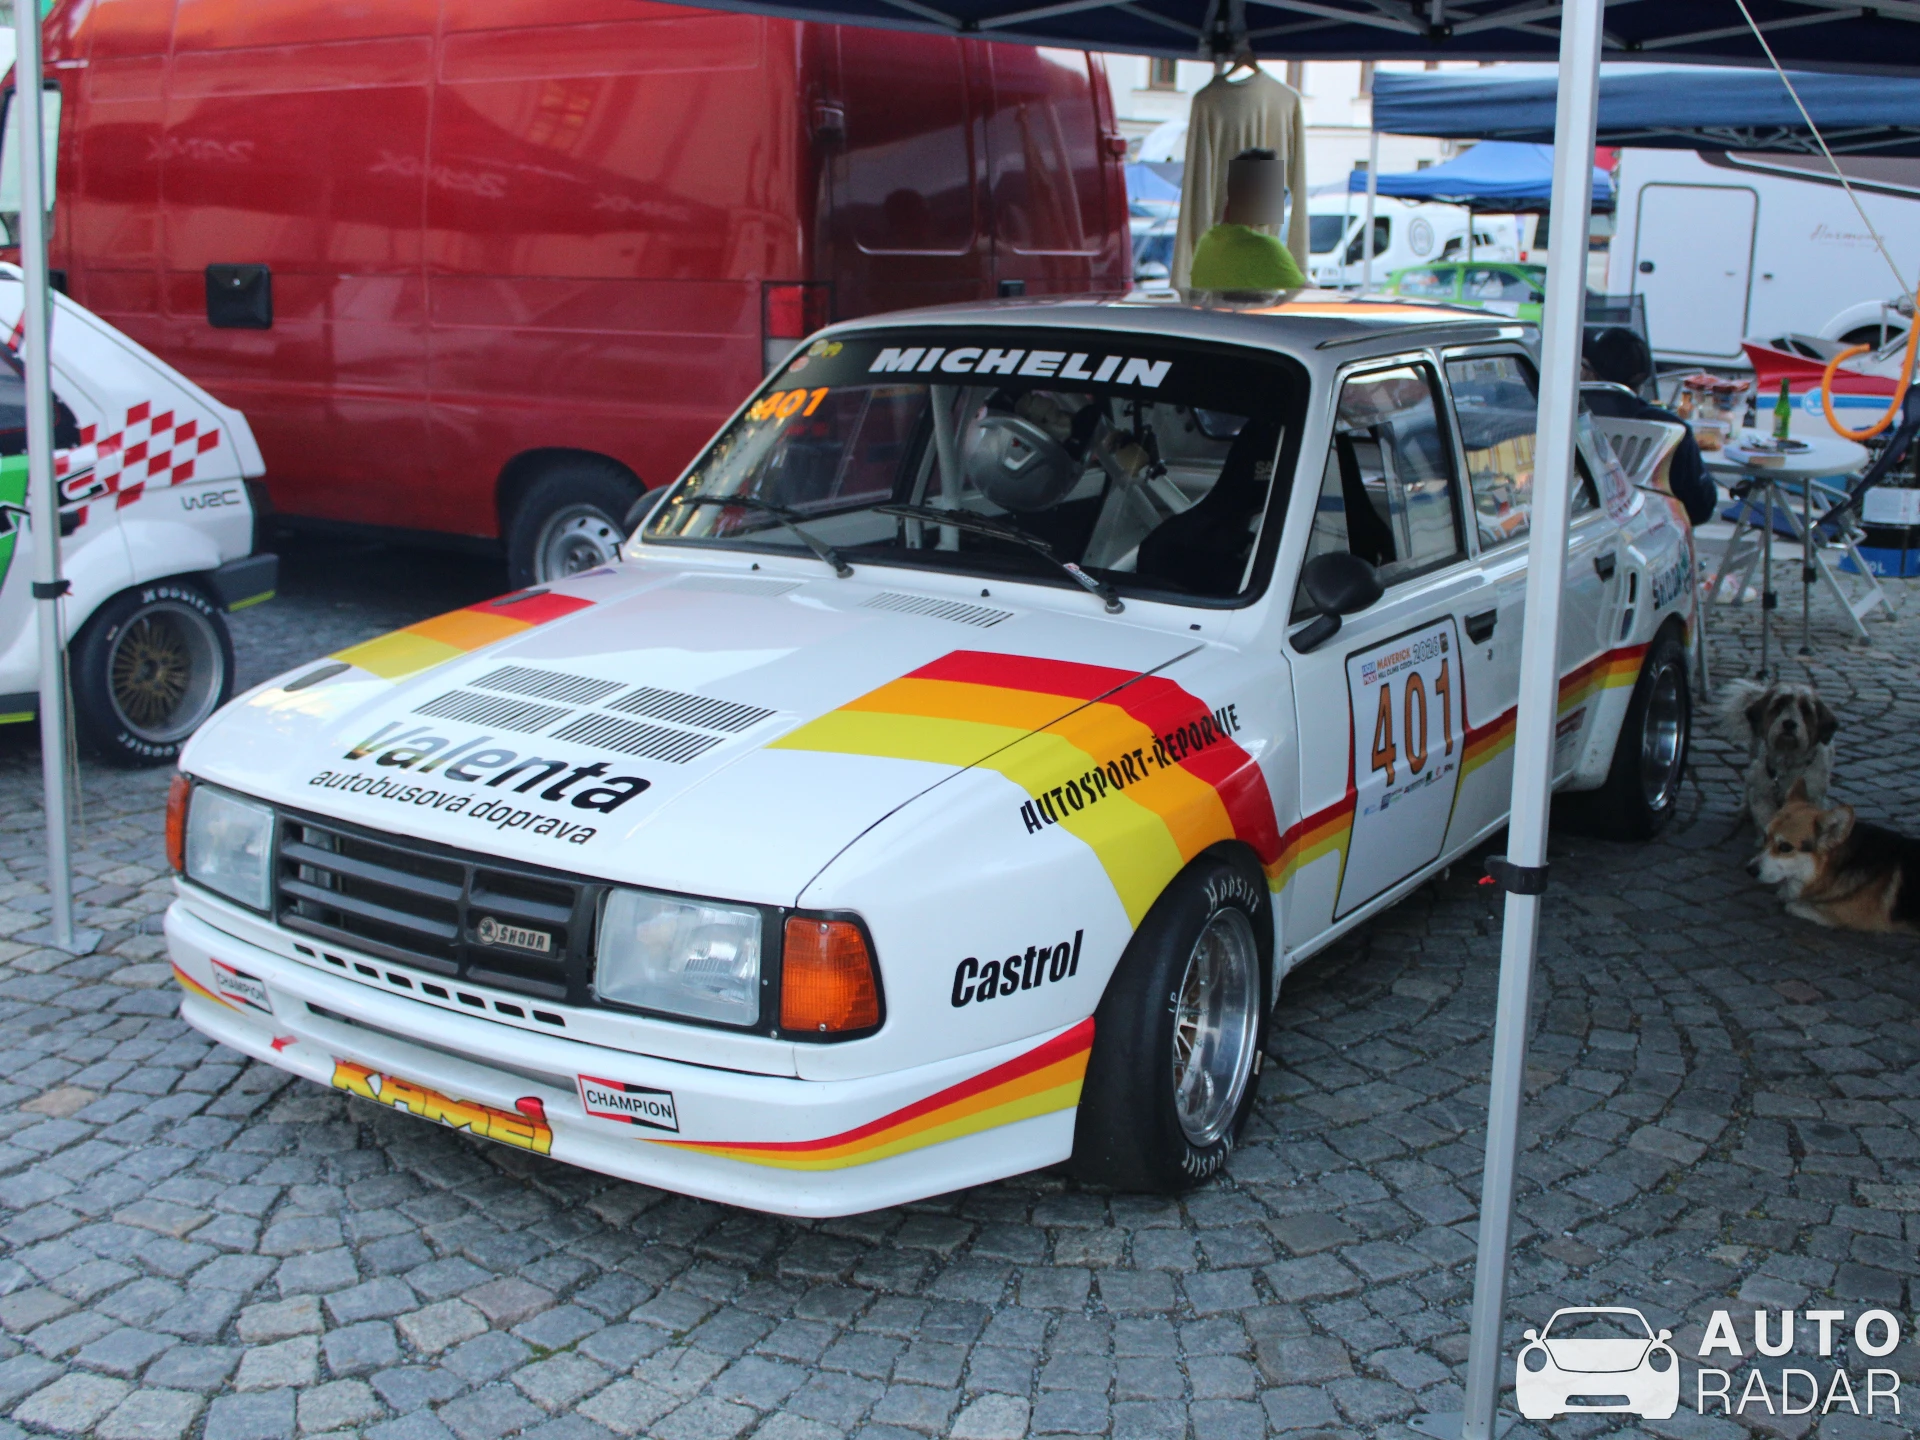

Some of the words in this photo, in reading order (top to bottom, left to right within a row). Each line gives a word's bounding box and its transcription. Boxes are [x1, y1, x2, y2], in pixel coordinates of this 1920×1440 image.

[868, 347, 1173, 388] MICHELIN
[754, 387, 830, 421] 401
[181, 489, 241, 510] WRC
[1377, 647, 1412, 671] MAVERICK
[1413, 635, 1440, 666] 2026
[1371, 657, 1454, 787] 401
[343, 721, 651, 814] Valenta
[309, 769, 473, 812] autobusová
[469, 799, 598, 846] doprava
[216, 972, 268, 1002] CHAMPION
[951, 929, 1084, 1008] Castrol
[587, 1090, 673, 1119] CHAMPION
